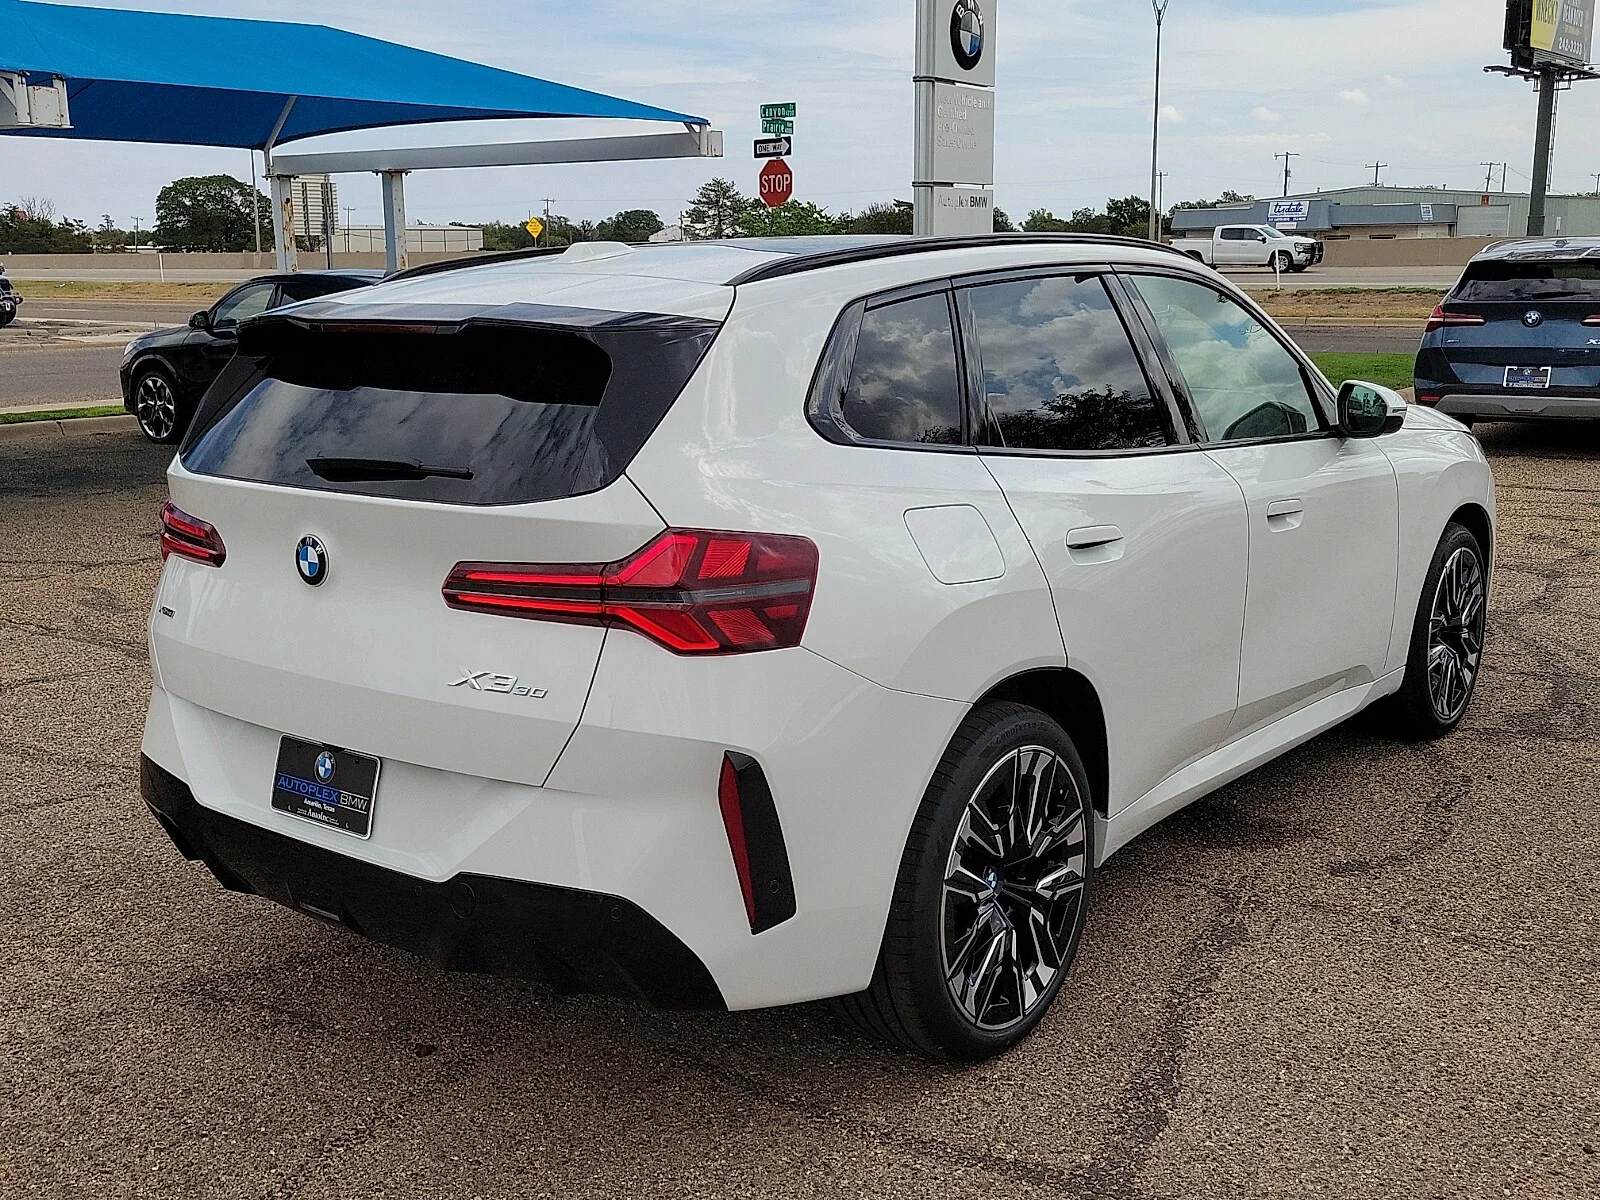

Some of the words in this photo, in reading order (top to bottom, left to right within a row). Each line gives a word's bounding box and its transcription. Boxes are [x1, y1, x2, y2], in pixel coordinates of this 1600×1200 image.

[1559, 37, 1583, 56] 242-3333
[761, 106, 786, 118] Canyon
[763, 121, 785, 133] Prairie
[772, 143, 782, 151] WAY
[761, 174, 791, 193] STOP
[970, 195, 988, 208] BMW
[278, 776, 339, 802] AUTOPLEX
[340, 793, 368, 810] BMW
